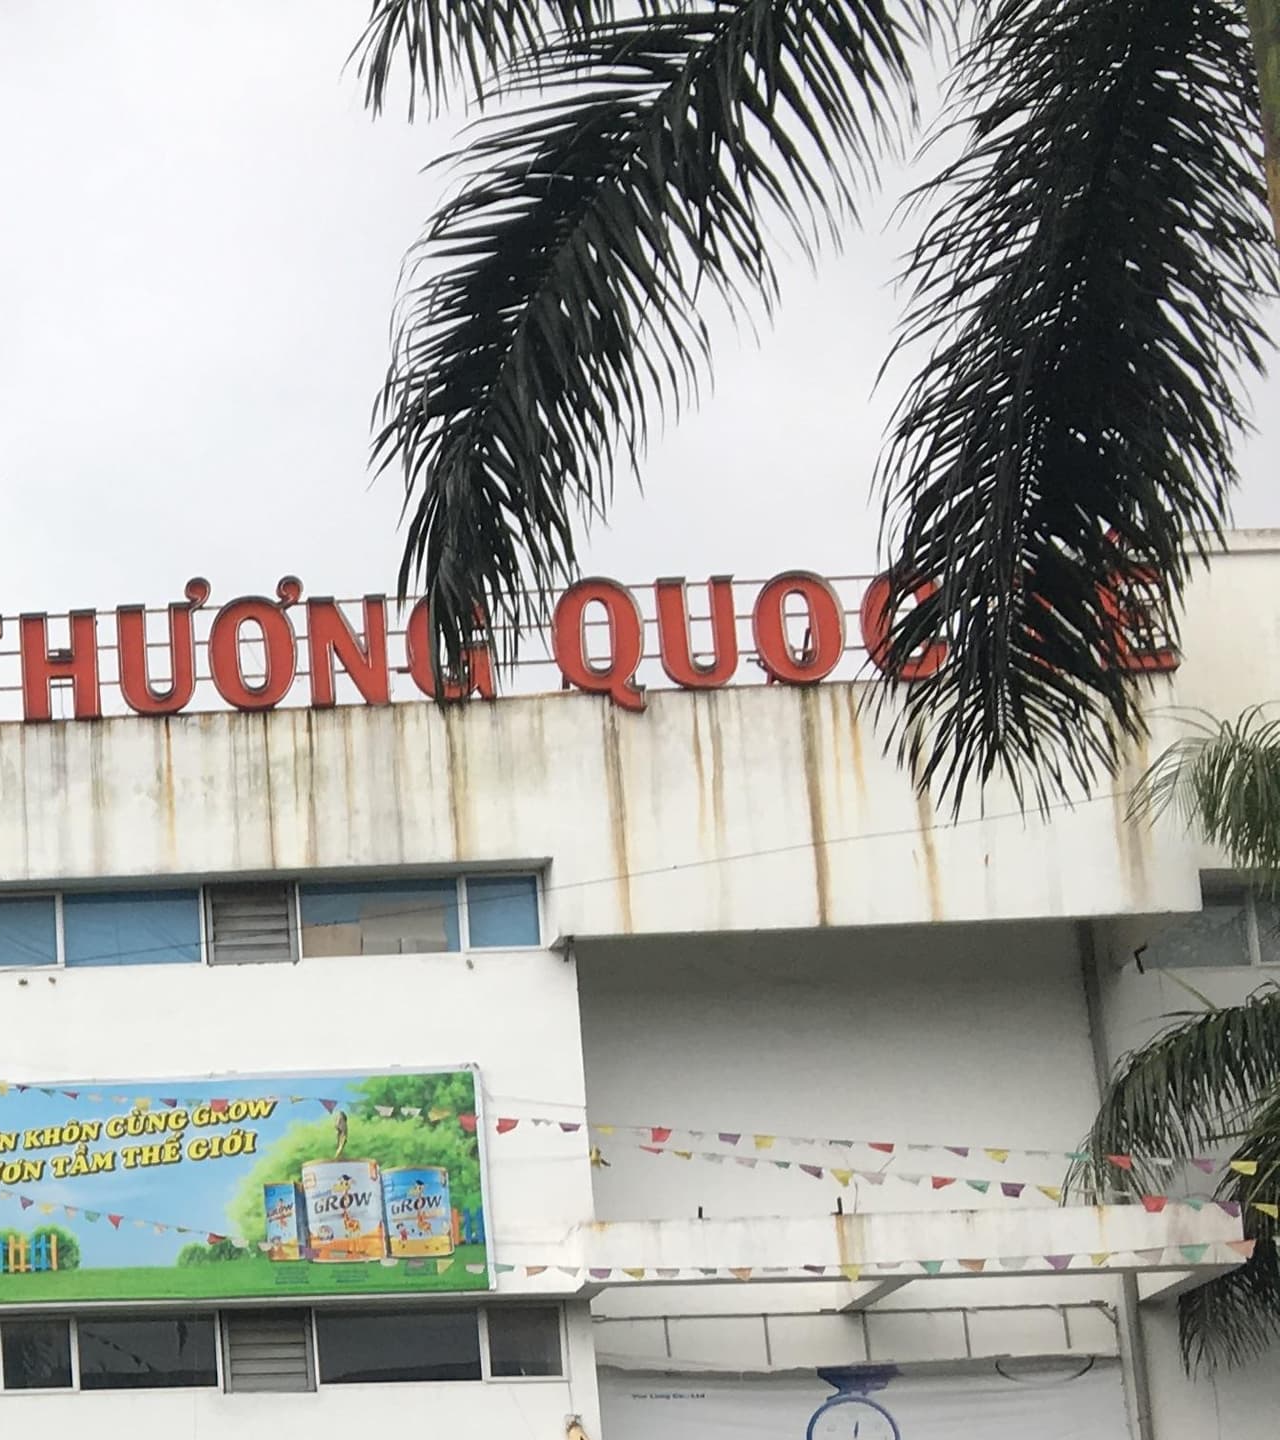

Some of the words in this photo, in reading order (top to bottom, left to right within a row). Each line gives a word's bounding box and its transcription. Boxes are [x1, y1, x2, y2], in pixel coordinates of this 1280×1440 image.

[23, 1119, 102, 1150] KHÔN
[105, 1106, 188, 1138] CÙNG
[122, 1132, 183, 1170] THẾ
[187, 1128, 258, 1161] GIỚI
[313, 1191, 373, 1215] GROW
[391, 1195, 443, 1215] GROW
